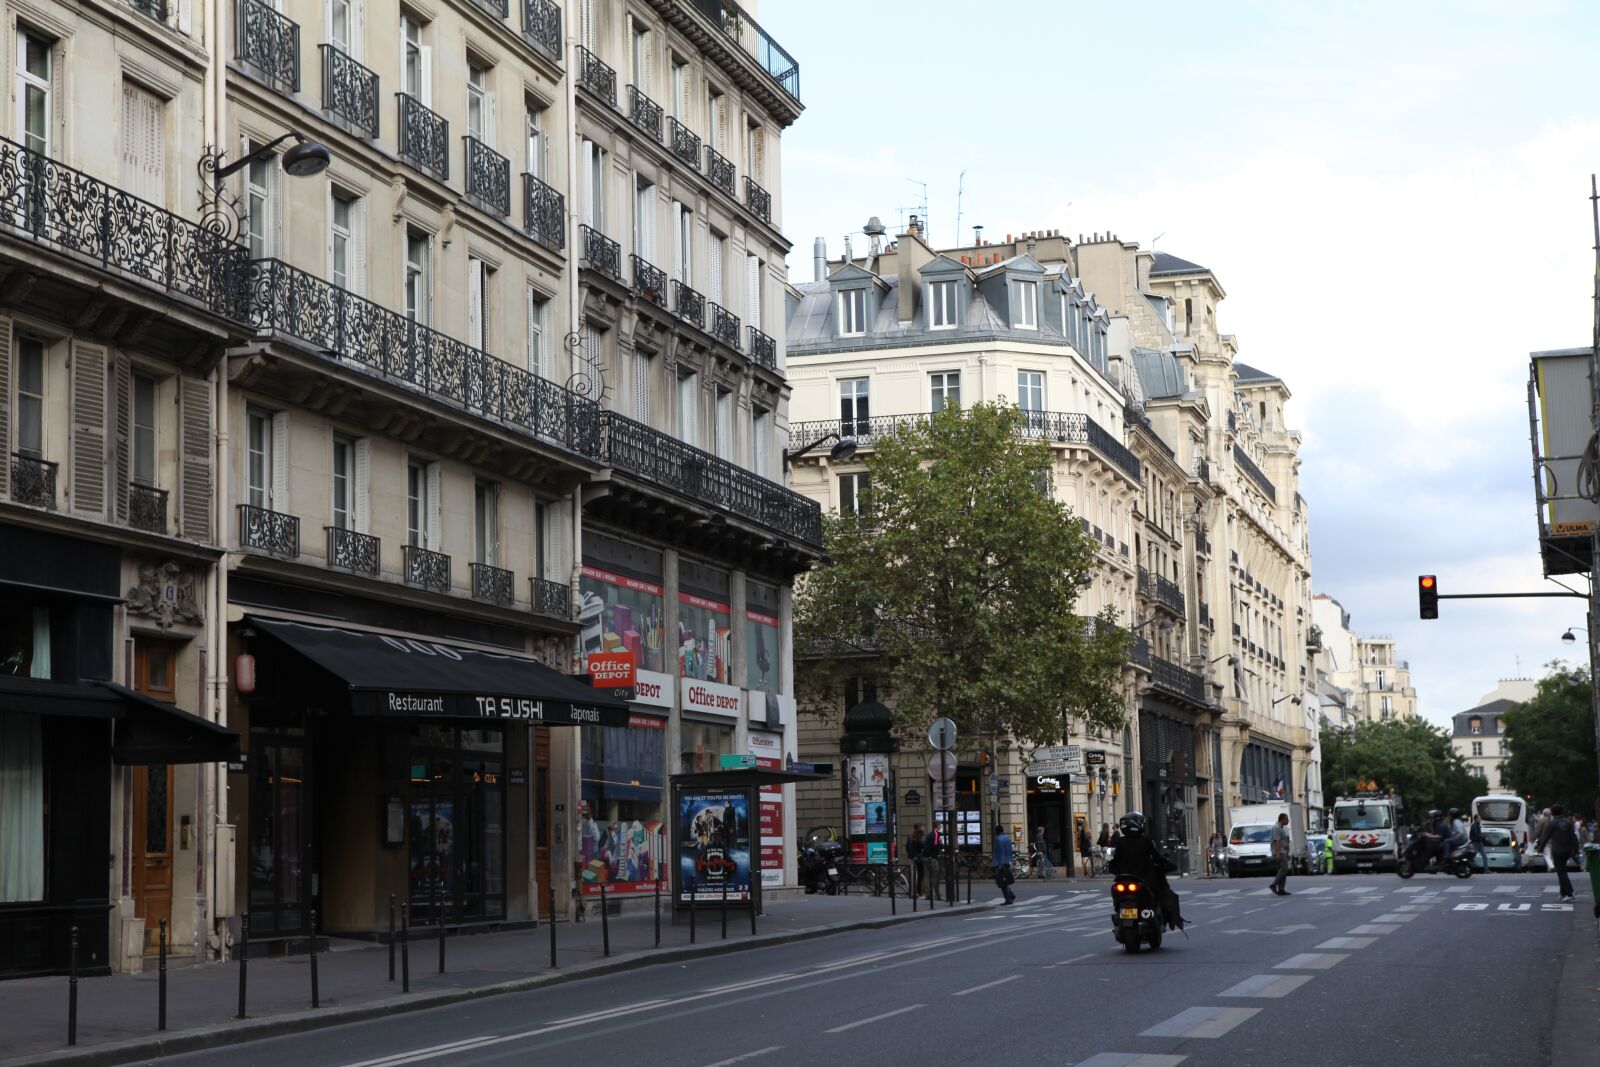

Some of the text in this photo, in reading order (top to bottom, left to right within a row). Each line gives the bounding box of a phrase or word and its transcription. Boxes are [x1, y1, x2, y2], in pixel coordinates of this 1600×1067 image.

[166, 586, 174, 600] 6
[590, 661, 631, 672] Office
[594, 671, 630, 680] DEPOT
[614, 688, 629, 699] City
[636, 682, 661, 699] DEPOT
[388, 692, 444, 713] Restaurant
[689, 686, 738, 711] Office DEPOT
[475, 696, 543, 719] TA SUSHI
[1451, 903, 1574, 912] BUS
